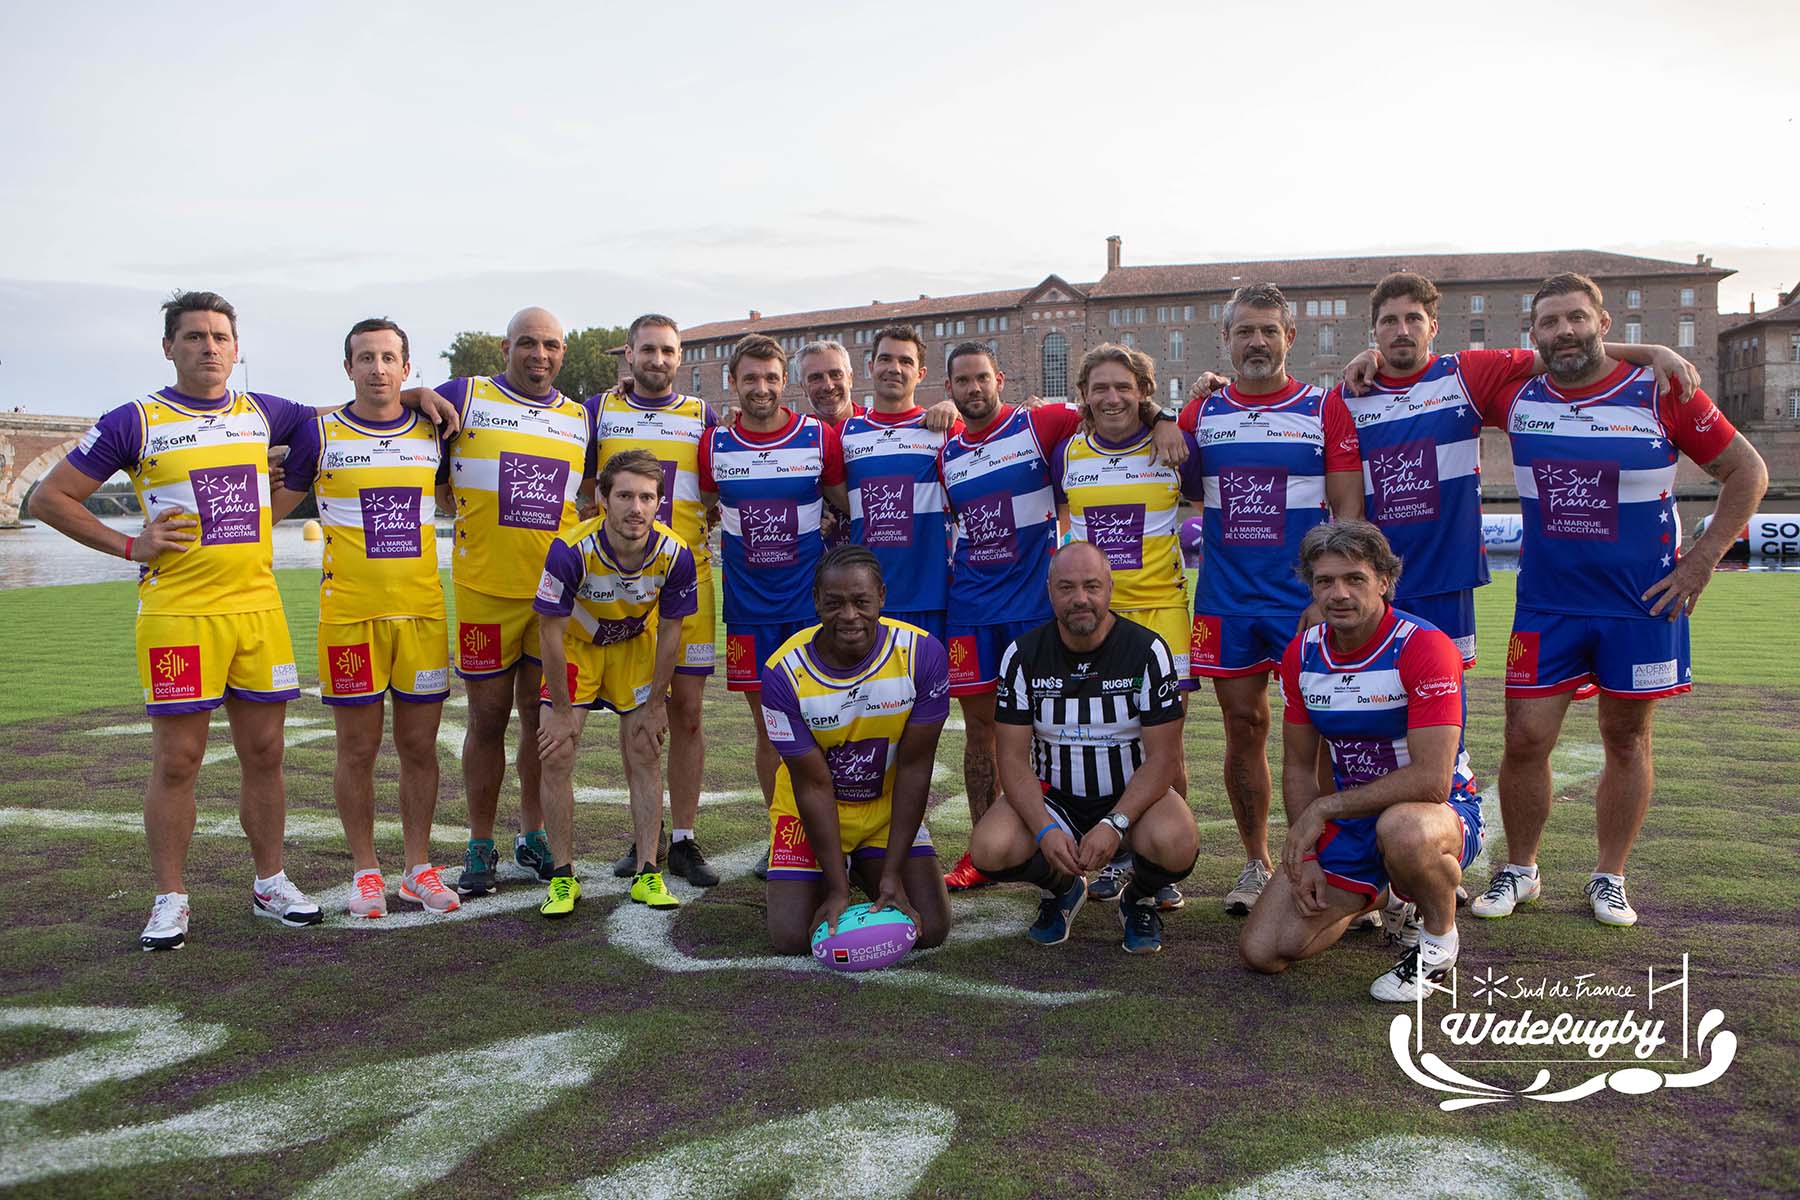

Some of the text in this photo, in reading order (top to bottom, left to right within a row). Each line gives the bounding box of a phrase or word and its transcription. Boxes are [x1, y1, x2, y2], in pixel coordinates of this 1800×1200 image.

[492, 418, 518, 427] GPM
[1358, 413, 1381, 422] GPM
[1528, 421, 1555, 429] GPM
[170, 434, 196, 445] GPM
[1214, 431, 1236, 439] GPM
[855, 446, 874, 454] GPM
[1395, 450, 1423, 471] Sud
[526, 465, 558, 482] Sud
[952, 470, 967, 480] GPM
[1397, 469, 1417, 480] de
[1563, 470, 1602, 486] Sud
[222, 474, 248, 492] Sud
[528, 480, 546, 491] de
[1243, 476, 1274, 493] Sud
[1381, 475, 1434, 502] France
[225, 492, 242, 503] de
[510, 482, 560, 504] France
[879, 484, 904, 500] Sud
[1245, 492, 1264, 504] de
[1568, 484, 1591, 498] de
[385, 496, 411, 511] Sud
[881, 500, 896, 511] de
[1229, 495, 1280, 520] France
[1395, 503, 1426, 512] MARQUE
[1548, 489, 1611, 512] France
[208, 497, 256, 522] France
[388, 511, 405, 521] de
[760, 508, 787, 524] Sud
[868, 504, 908, 526] France
[978, 501, 1001, 521] Sud
[372, 513, 416, 536] France
[982, 518, 997, 531] de
[1105, 512, 1134, 526] Sud
[764, 523, 781, 533] de
[970, 524, 1012, 546] France
[1558, 526, 1609, 534] L'OCCITANIE
[749, 526, 793, 547] France
[1095, 528, 1138, 545] France
[155, 685, 195, 694] Occitanie
[1309, 695, 1330, 704] GPM
[812, 715, 839, 725] GPM
[847, 748, 876, 764] Sud
[1358, 750, 1375, 765] de
[846, 762, 865, 775] de
[1342, 754, 1388, 776] France
